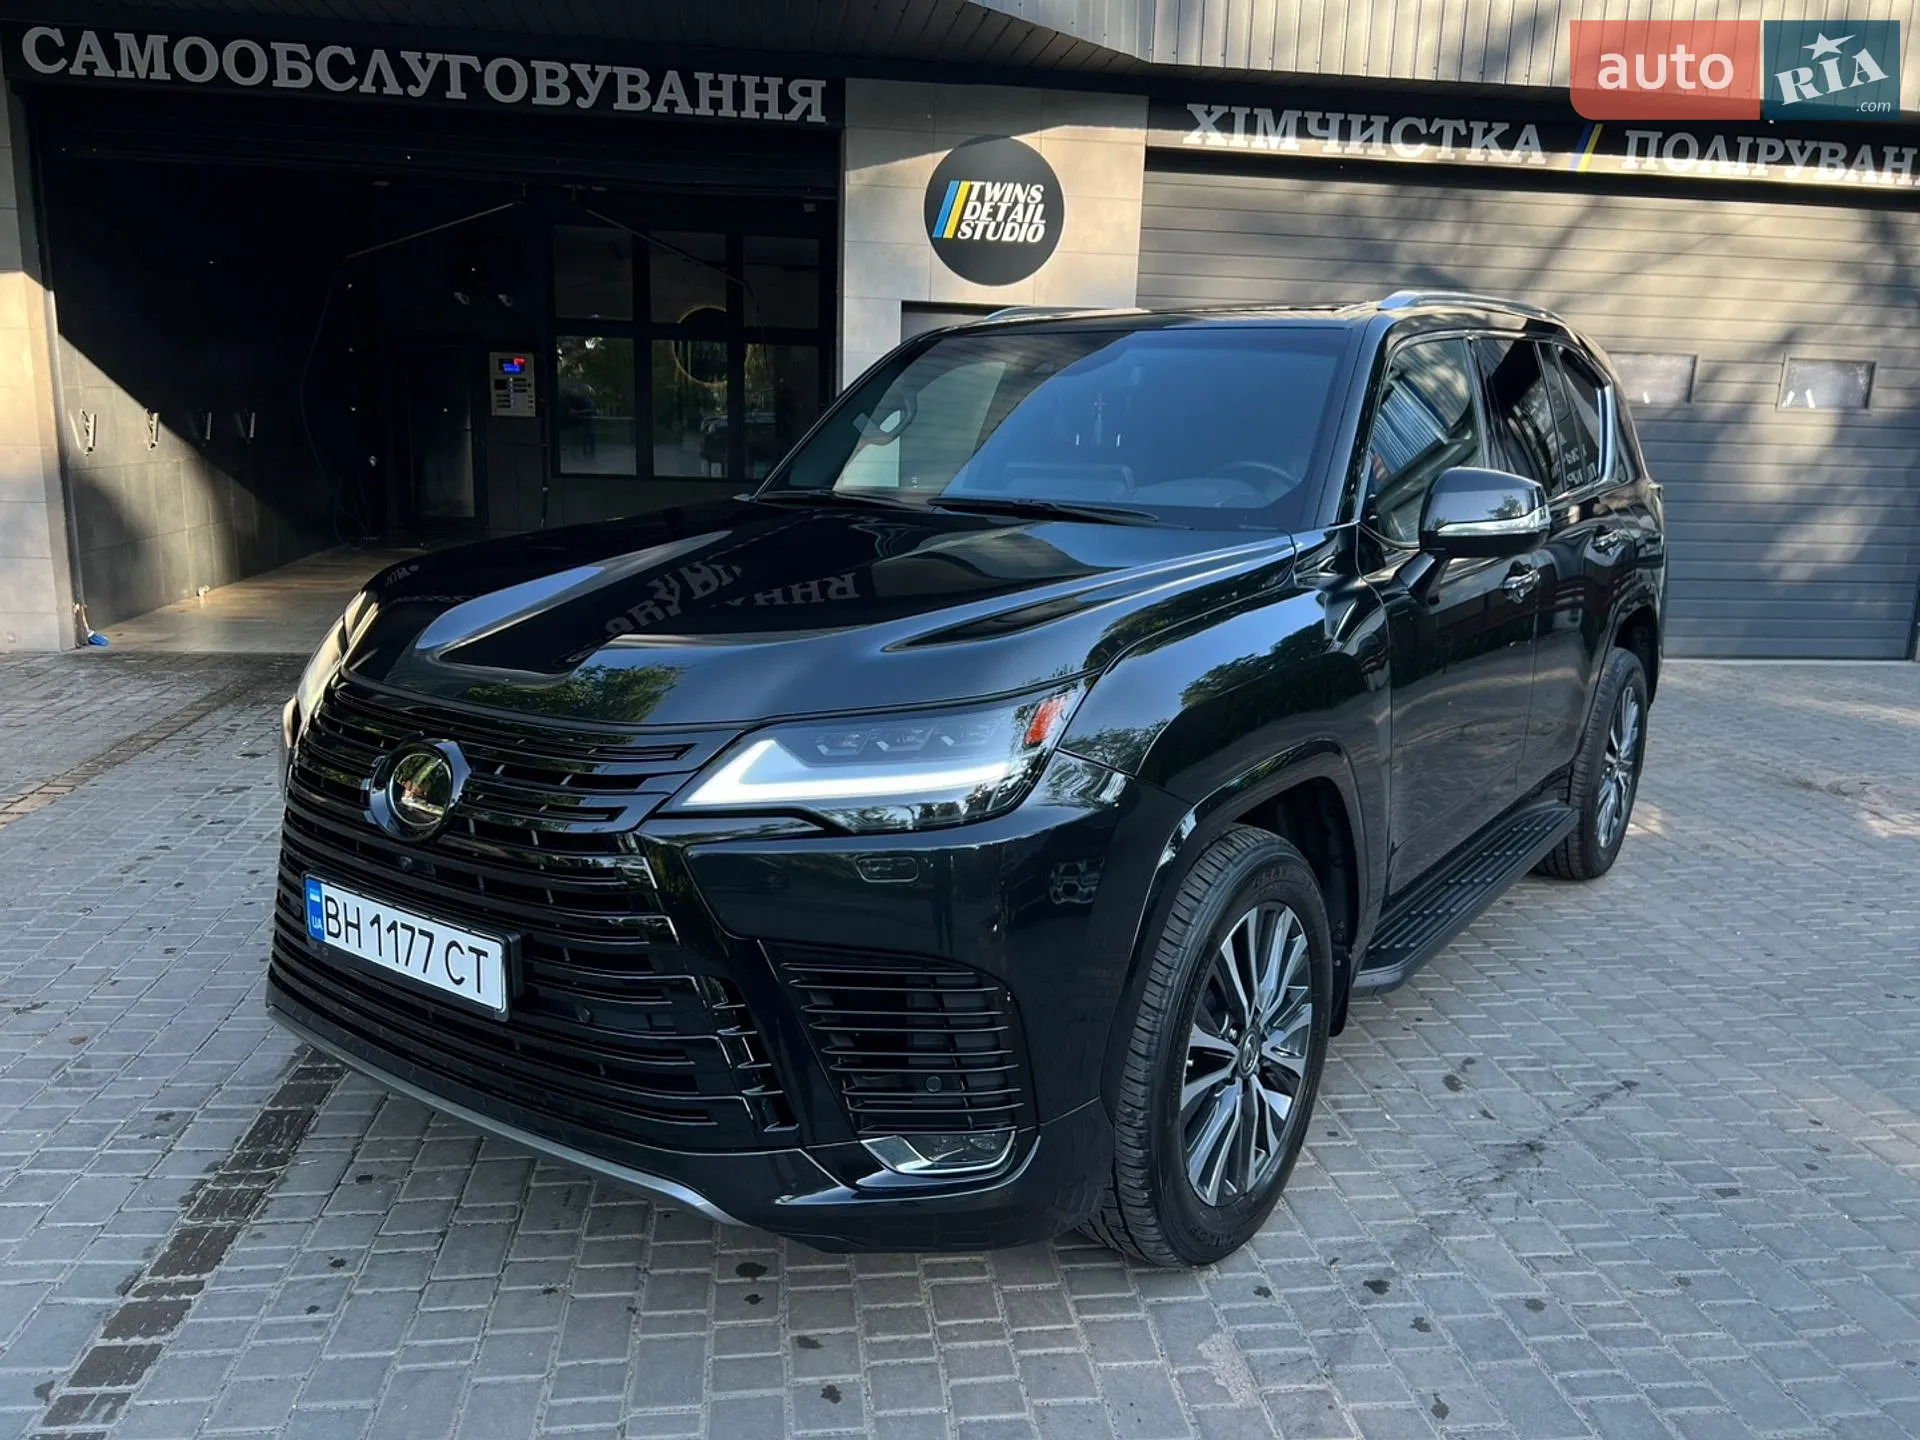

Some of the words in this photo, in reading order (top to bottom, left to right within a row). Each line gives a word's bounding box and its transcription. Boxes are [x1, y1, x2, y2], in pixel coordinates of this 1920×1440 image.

[21, 26, 828, 123] САМООБСЛУГОВУВАННЯ
[1183, 103, 1547, 165] ХІМЧИСТКА
[1620, 129, 1920, 185] ПОЛІРУВАН
[962, 201, 1046, 224] DETAIL
[969, 181, 1044, 204] TWINS
[957, 220, 1046, 243] STUDIO
[324, 895, 362, 949] BH
[369, 913, 435, 974] 1177
[445, 940, 489, 994] CT
